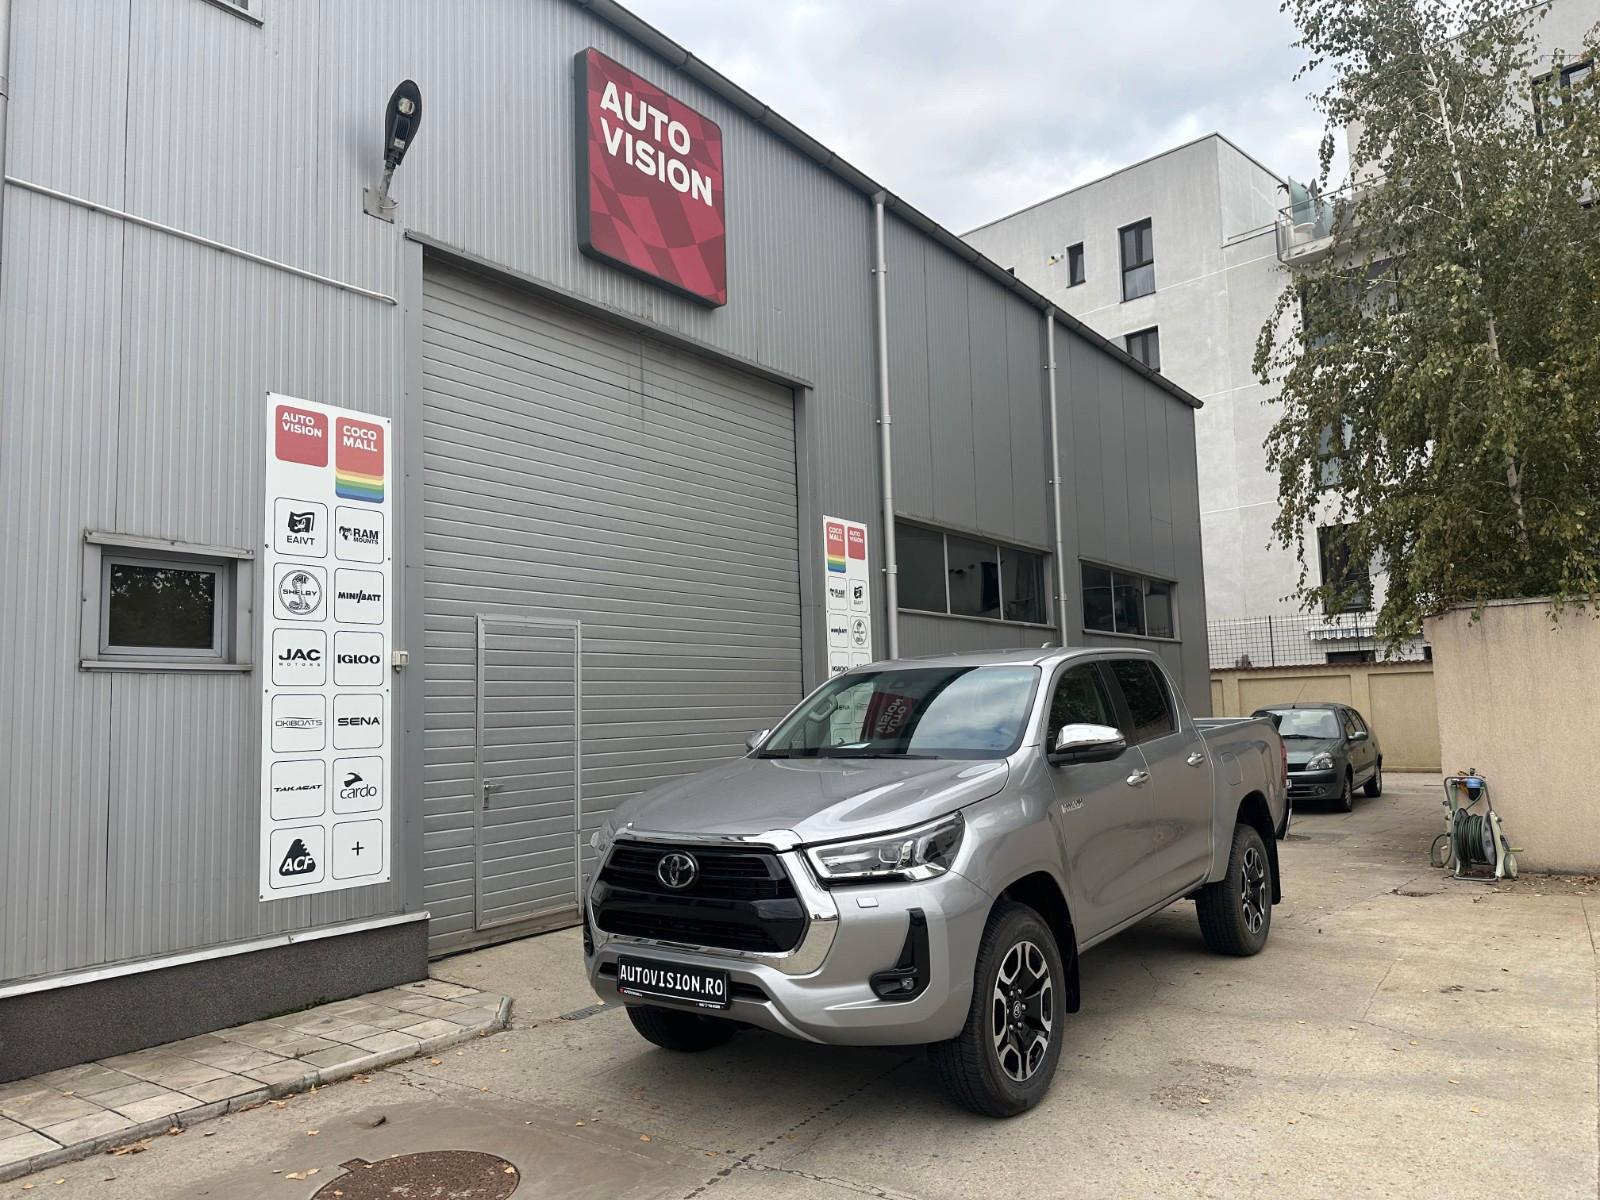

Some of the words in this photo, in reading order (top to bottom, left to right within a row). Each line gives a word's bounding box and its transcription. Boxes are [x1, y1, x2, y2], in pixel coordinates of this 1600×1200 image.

[599, 80, 691, 155] AUTO
[600, 117, 713, 207] VISION
[282, 411, 315, 426] AUTO
[282, 422, 323, 438] VISION
[343, 425, 377, 441] COCO
[343, 436, 378, 452] MALL
[353, 528, 379, 540] RAM
[828, 527, 843, 535] COCO
[286, 535, 315, 546] EAIVT
[353, 537, 379, 545] MOUNTS
[829, 534, 843, 542] MALL
[282, 588, 318, 597] SHELBY
[278, 648, 321, 661] JAC
[337, 654, 381, 665] IGLOO
[275, 719, 323, 727] OKIBOATS
[337, 716, 381, 727] SENA
[340, 784, 378, 800] cardo
[282, 855, 315, 872] ACF
[619, 964, 724, 996] AUTOVISION.RO
